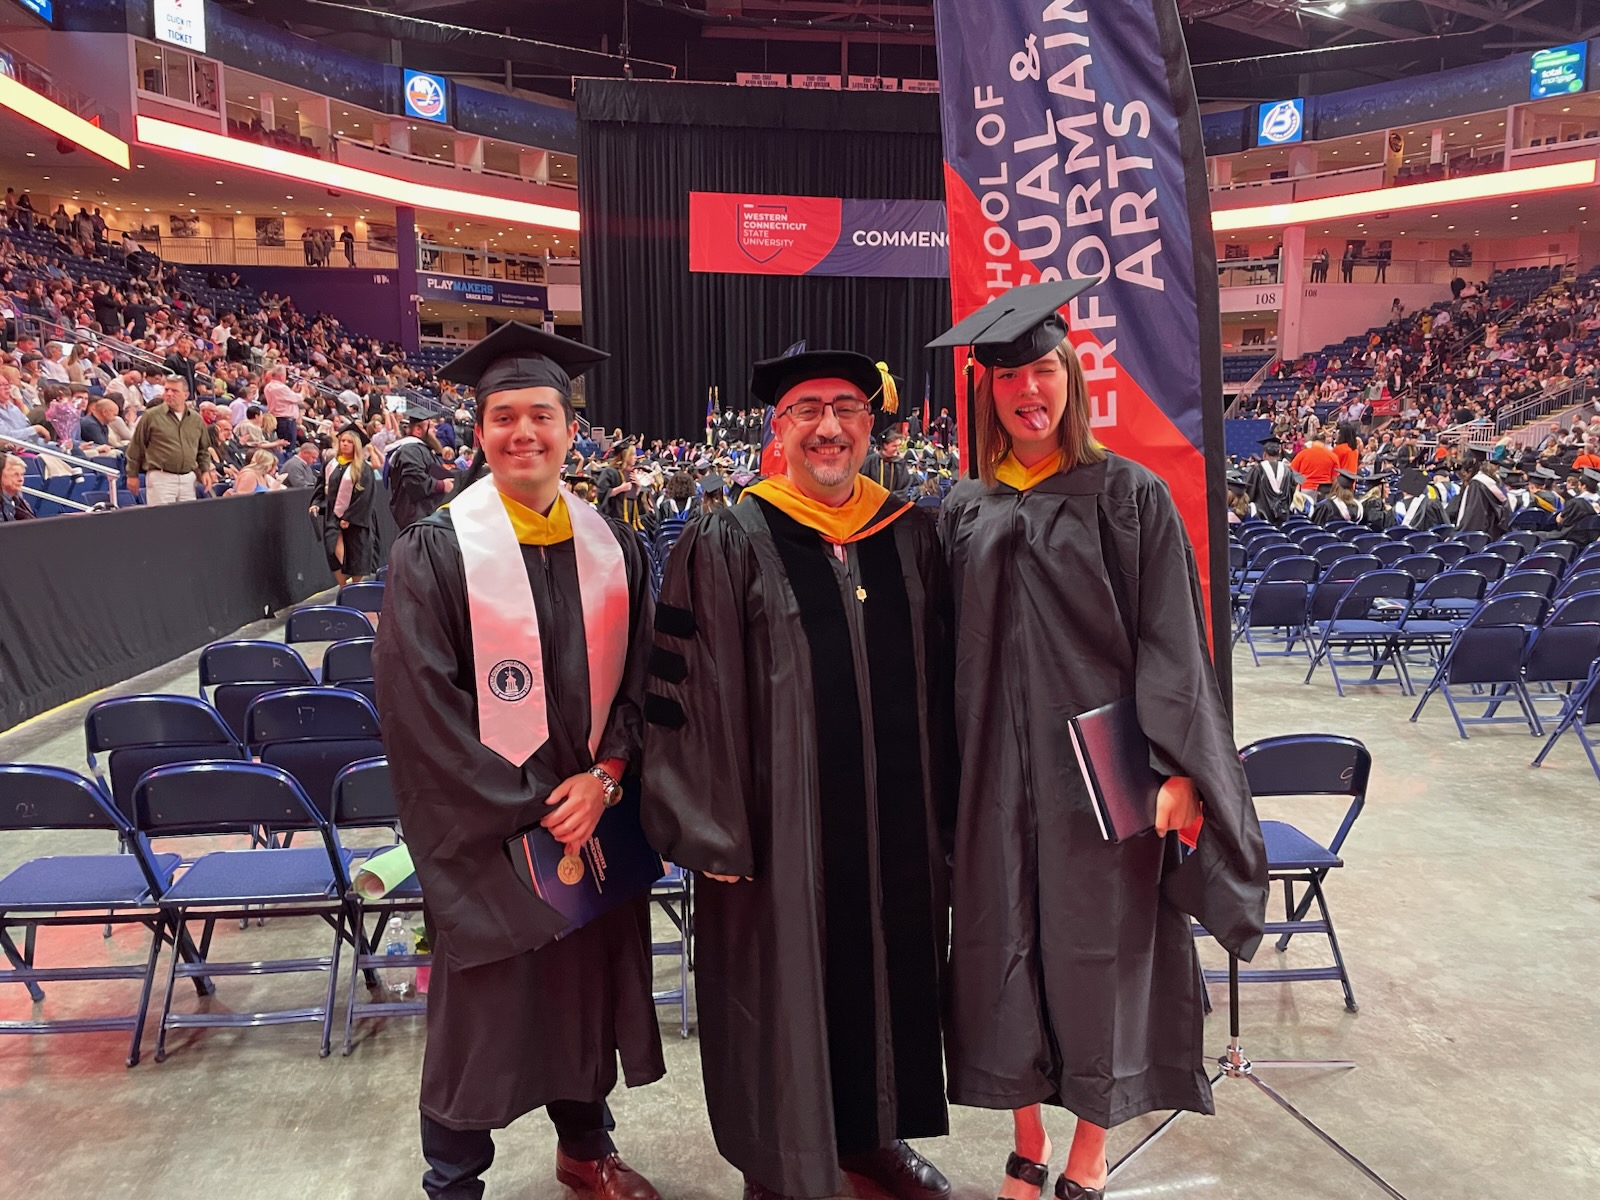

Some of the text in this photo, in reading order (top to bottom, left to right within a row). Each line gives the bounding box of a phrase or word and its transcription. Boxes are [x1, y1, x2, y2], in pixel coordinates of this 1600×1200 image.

[166, 13, 184, 25] CLICK
[186, 20, 192, 28] IT
[168, 29, 193, 45] TICKET
[1009, 33, 1041, 81] &
[974, 85, 1006, 146] OF
[1103, 99, 1165, 291] ARTS
[744, 212, 788, 222] WESTERN
[743, 220, 807, 231] CONNECTICUT
[743, 230, 769, 238] STATE
[743, 237, 794, 247] UNIVERSITY
[427, 278, 494, 295] PLAYMAKERS
[1256, 293, 1276, 305] 108
[1304, 289, 1318, 298] 108
[272, 656, 284, 668] R
